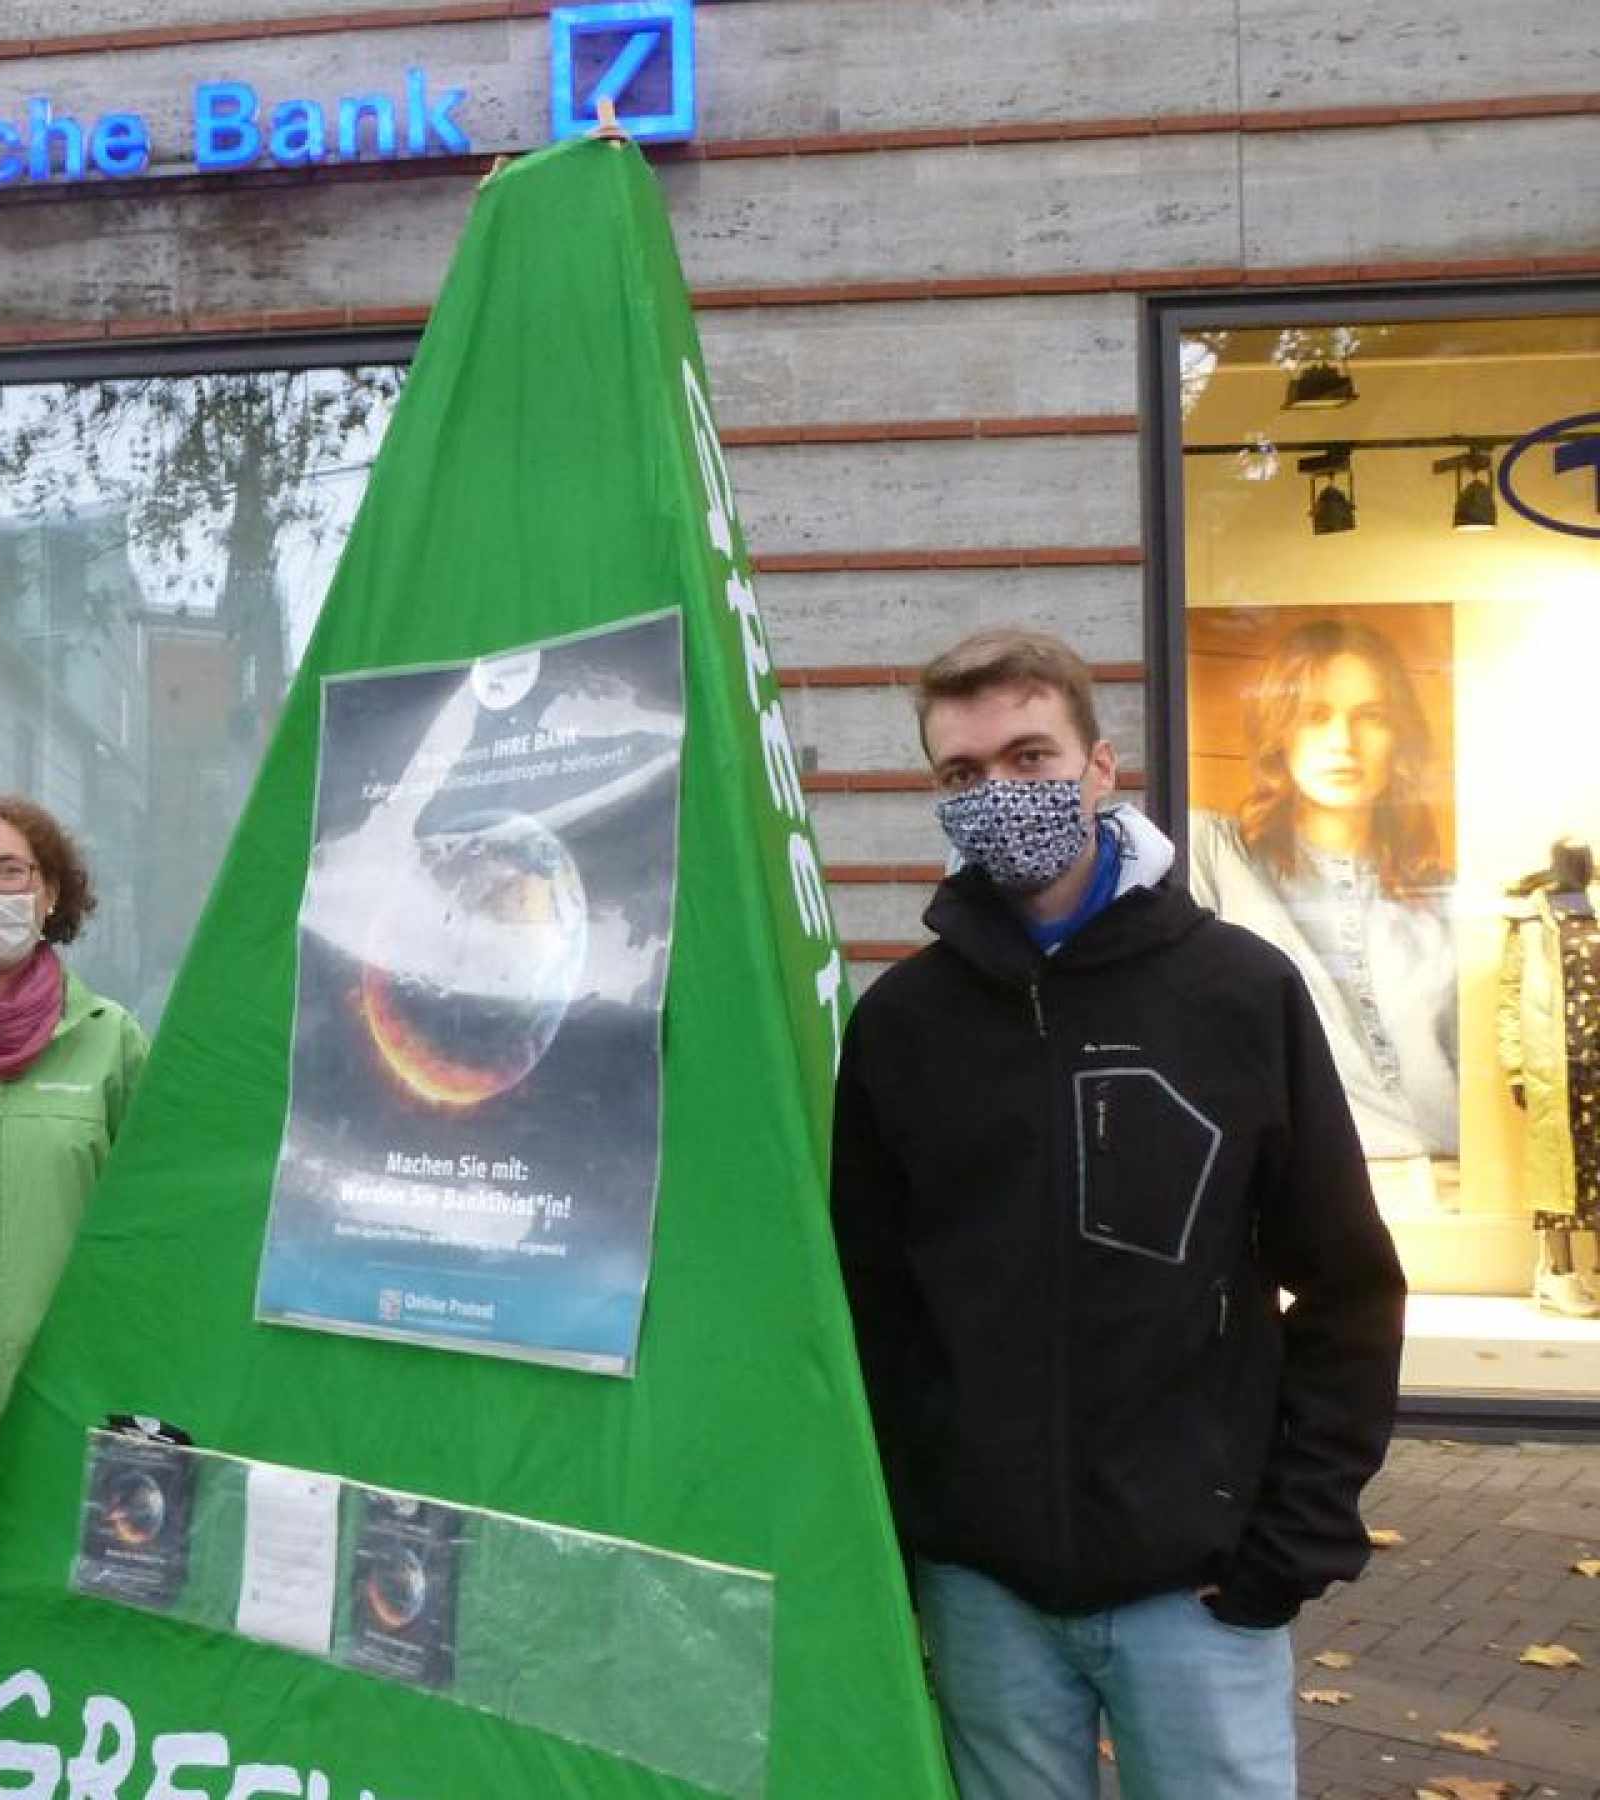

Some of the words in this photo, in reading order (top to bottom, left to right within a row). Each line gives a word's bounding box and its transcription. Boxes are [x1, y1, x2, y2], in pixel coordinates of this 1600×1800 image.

[196, 66, 470, 169] Bank
[386, 1151, 453, 1176] Machen
[458, 1154, 487, 1179] Sie
[492, 1156, 529, 1182] mit:
